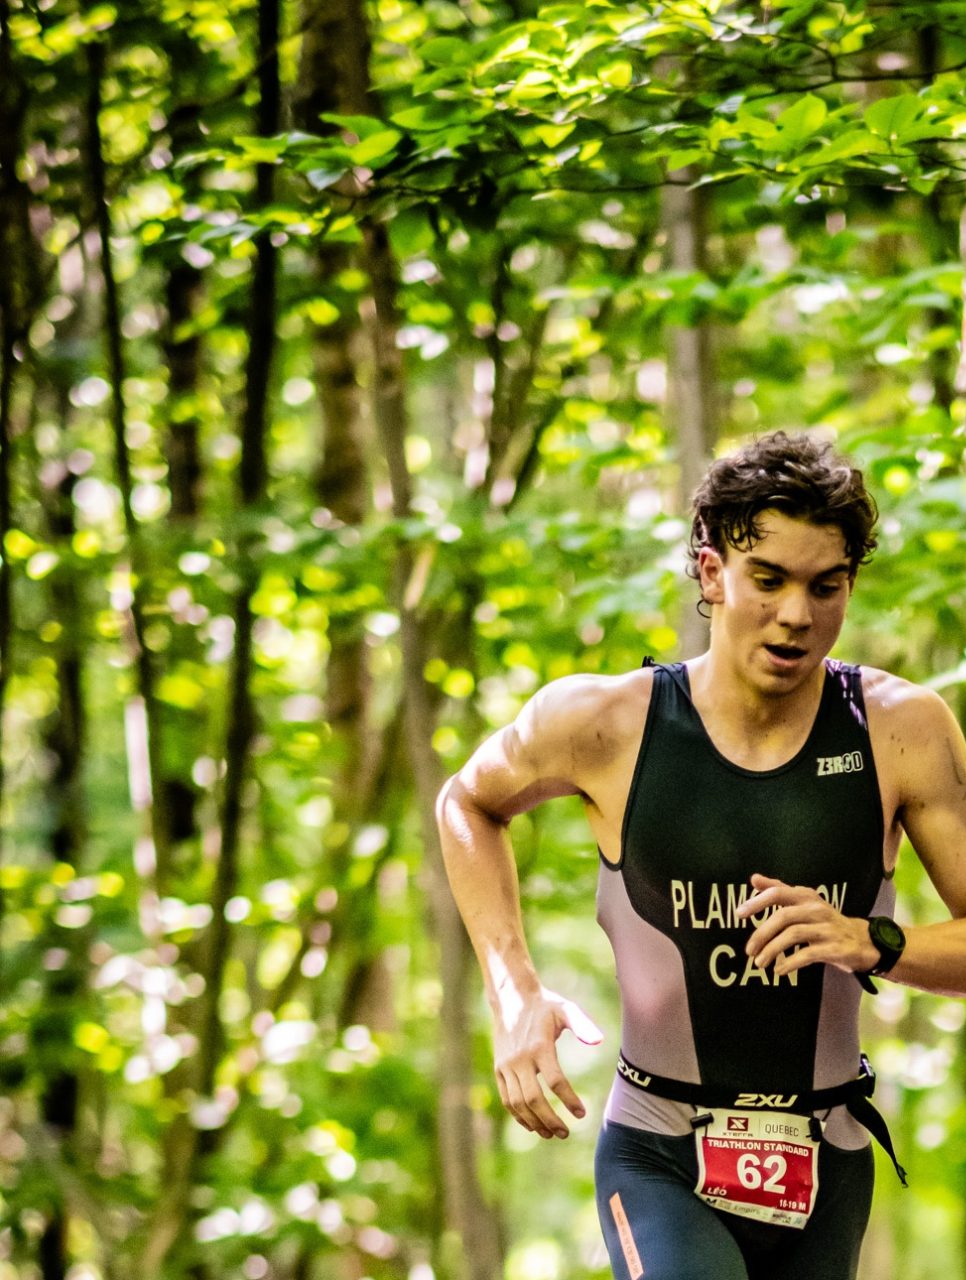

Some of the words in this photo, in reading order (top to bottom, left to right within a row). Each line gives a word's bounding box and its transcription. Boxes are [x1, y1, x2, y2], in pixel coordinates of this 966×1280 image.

[709, 944, 801, 987] CAN
[734, 1093, 799, 1107] 2XU
[707, 1138, 761, 1151] TRIATHLON
[764, 1142, 809, 1156] STANDARD
[737, 1153, 787, 1195] 62
[798, 1201, 807, 1212] M
